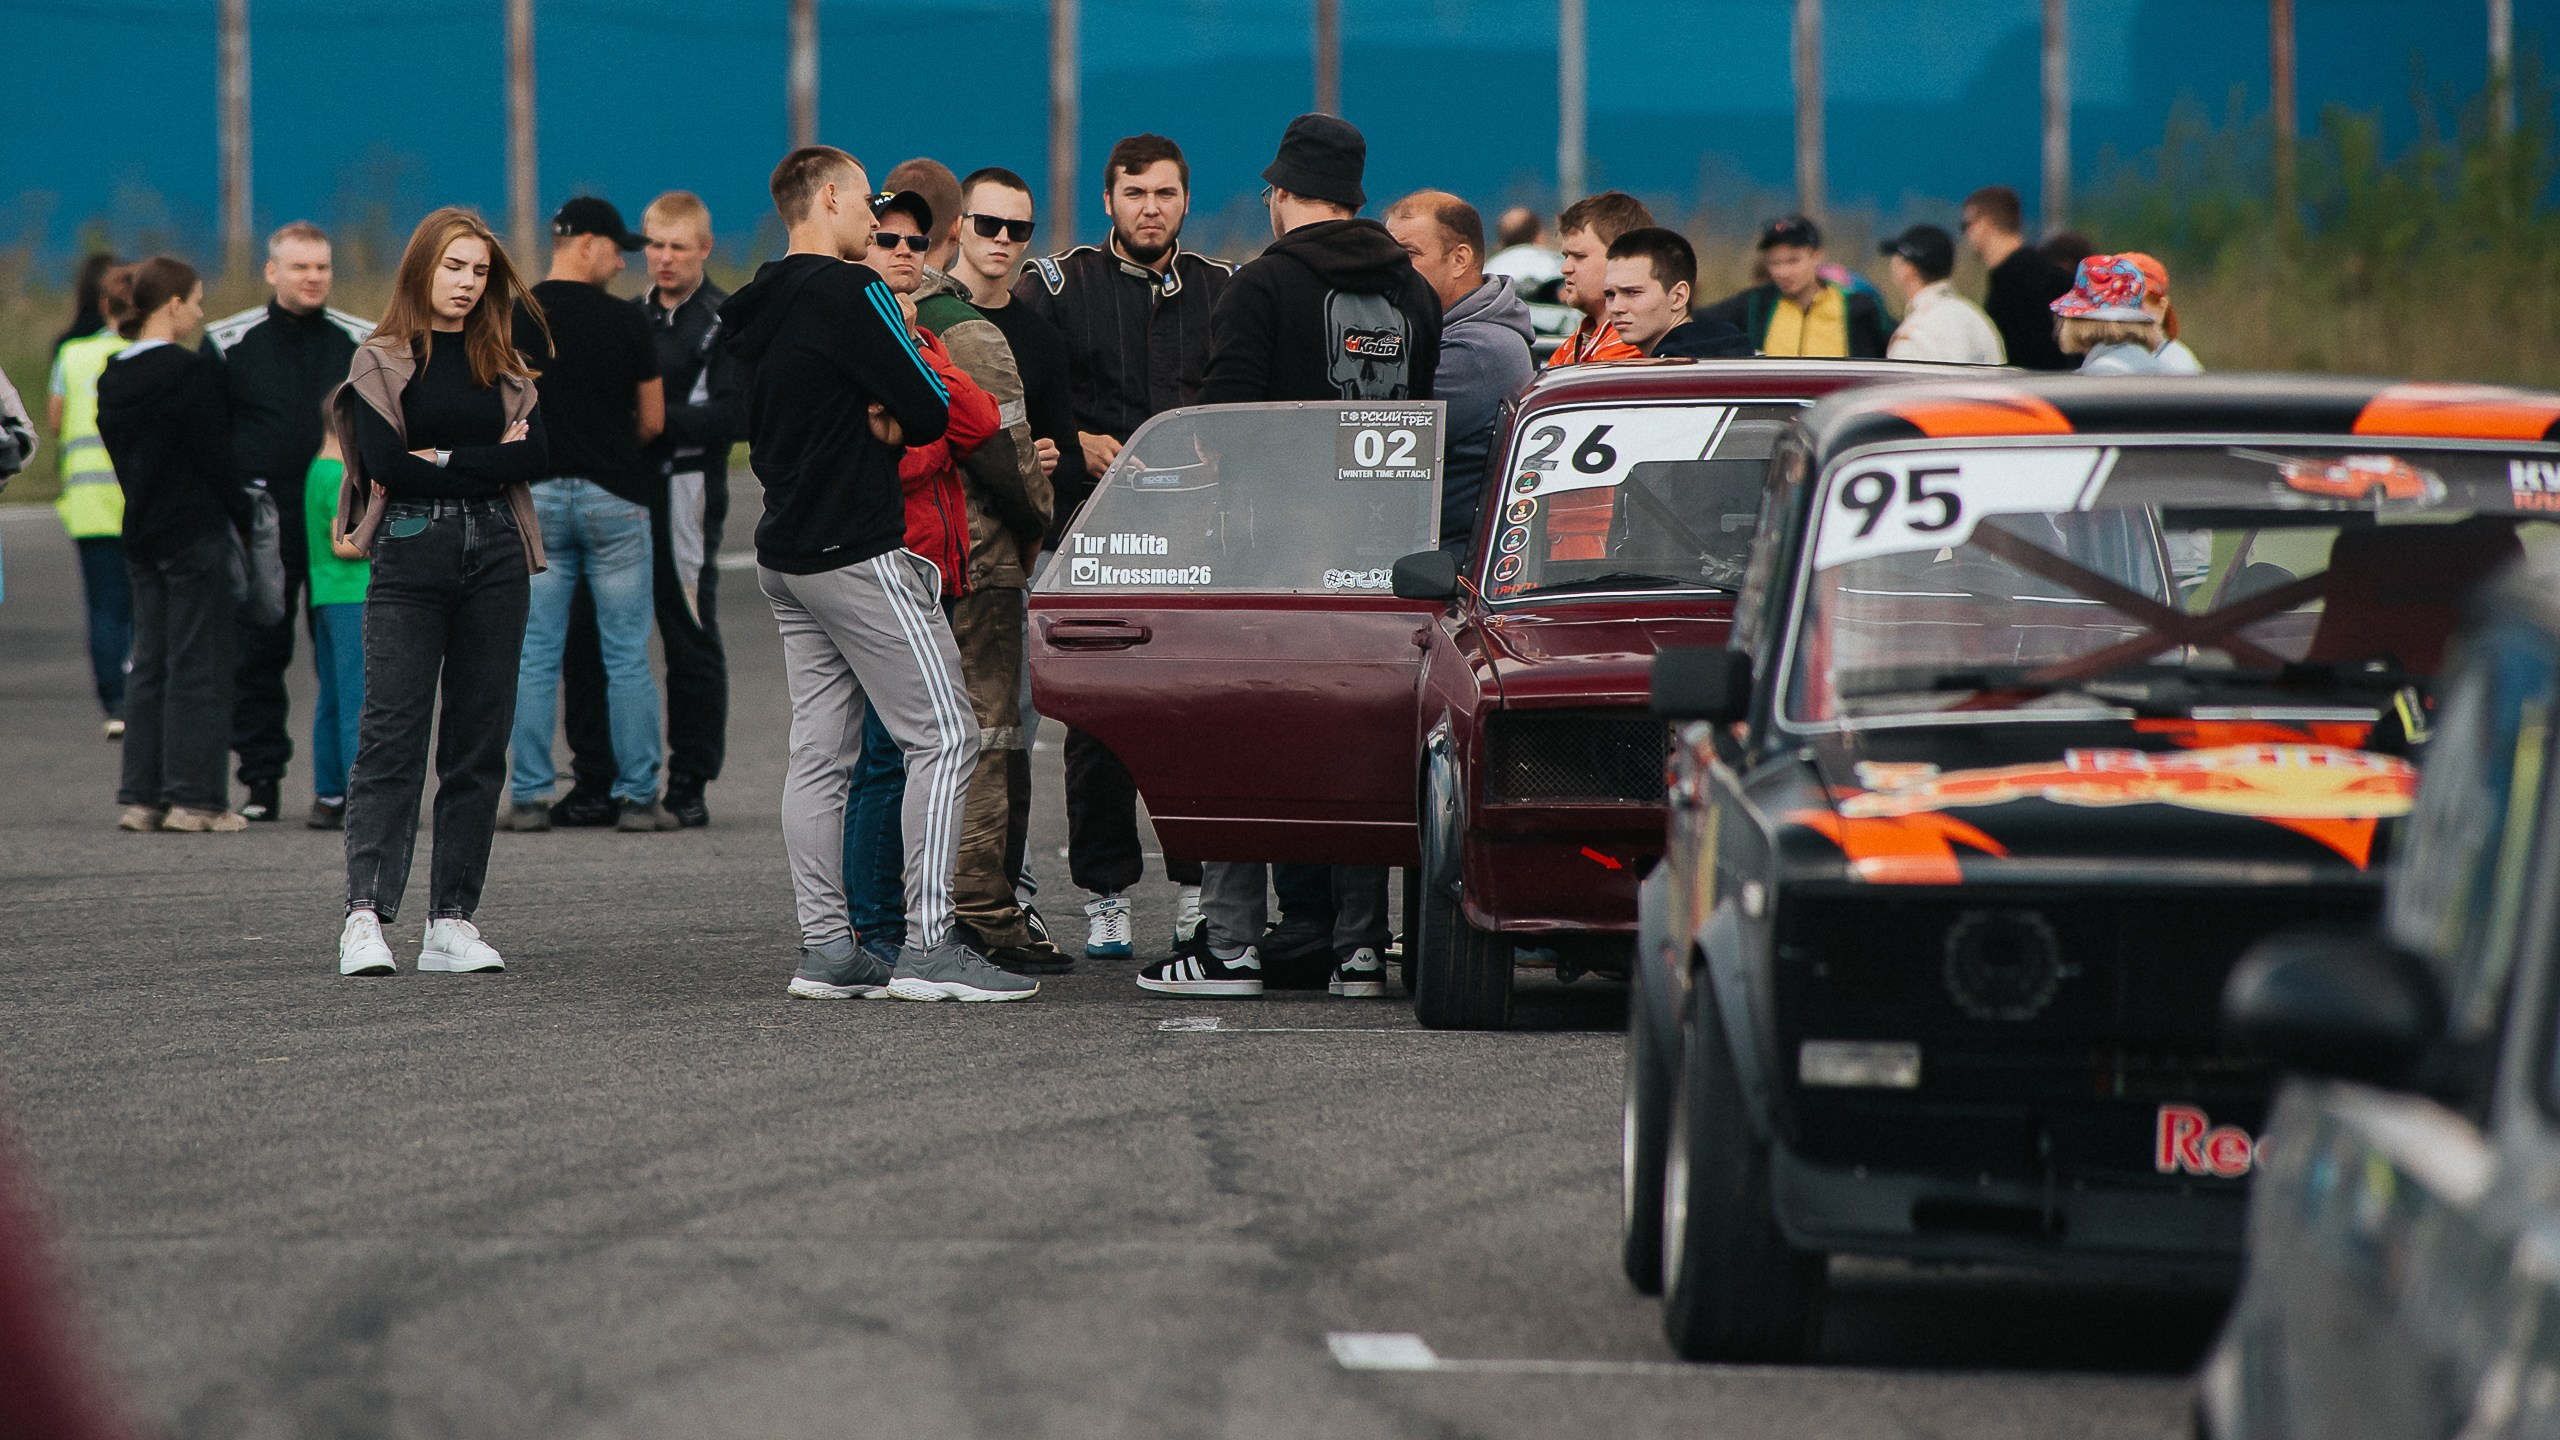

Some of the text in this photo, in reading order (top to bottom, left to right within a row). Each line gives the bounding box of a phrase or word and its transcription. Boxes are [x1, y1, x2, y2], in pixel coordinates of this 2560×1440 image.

[1402, 415, 1433, 427] ТРЕК
[1354, 429, 1417, 467] 02
[1519, 424, 1618, 475] 26
[1375, 469, 1395, 478] TIME
[1841, 467, 1963, 538] 95
[1072, 533, 1168, 555] Tur Nikita
[1100, 565, 1212, 585] Krossmen26
[1099, 900, 1117, 909] OMP
[2156, 1104, 2272, 1178] Re
